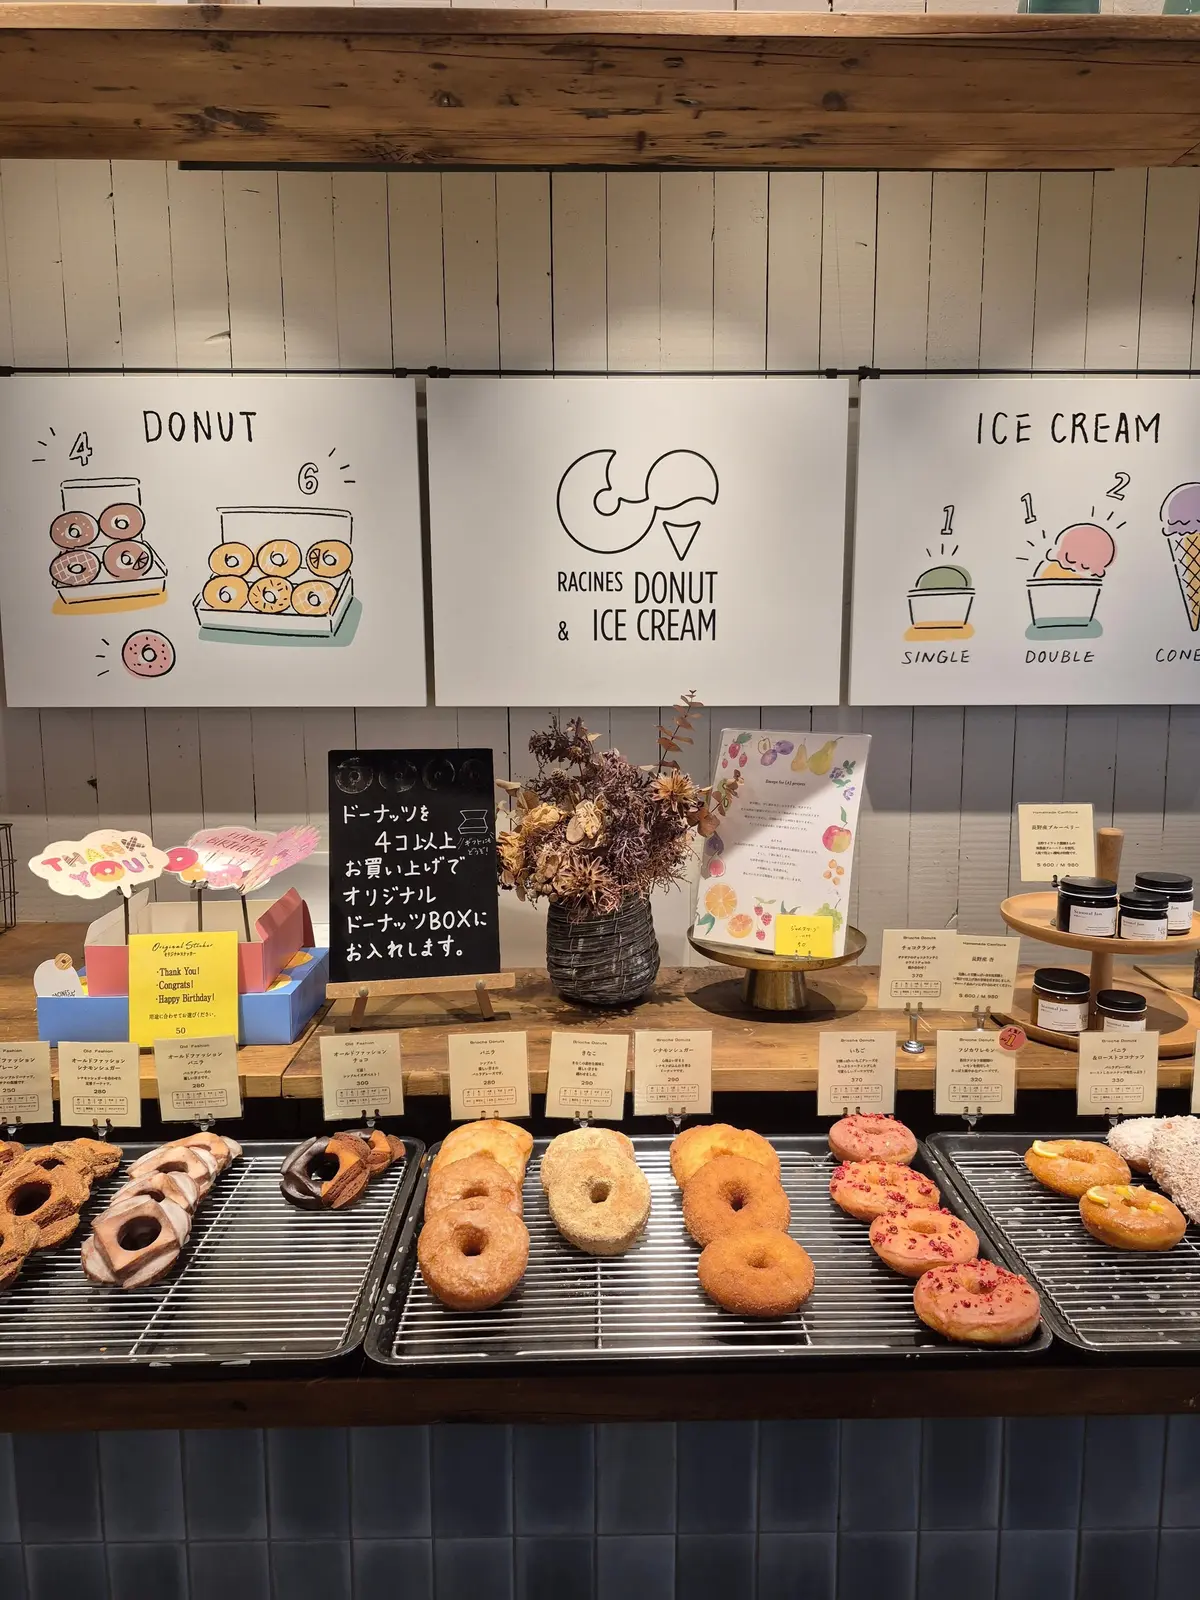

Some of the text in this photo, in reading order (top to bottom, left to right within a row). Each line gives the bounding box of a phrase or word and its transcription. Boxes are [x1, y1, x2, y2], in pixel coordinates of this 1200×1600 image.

[143, 410, 257, 443] DONUT
[977, 411, 1161, 445] ICE CREAM
[69, 431, 93, 466] 4
[297, 462, 319, 495] 6
[1107, 471, 1131, 501] 2
[940, 504, 956, 536] 1
[1020, 492, 1037, 524] 1
[557, 570, 718, 605] RACINES DONUT
[558, 608, 717, 642] & ICE CREAM
[901, 649, 971, 665] SINGLE
[1025, 649, 1095, 665] DOUBLE
[343, 803, 430, 824] ドーナッツを
[206, 836, 265, 857] BIRTHDAY
[227, 831, 269, 847] HAPPY
[41, 836, 146, 872] THANK
[344, 856, 466, 879] お買い上げで
[342, 885, 436, 907] オリジナル
[347, 908, 488, 934] ドーナッツBOXに
[346, 935, 463, 962] お入れします。
[184, 966, 200, 976] You!
[182, 992, 215, 1003] Birthday!
[175, 1027, 186, 1035] 50
[167, 1051, 223, 1060] オールドファッション
[333, 1049, 388, 1057] オールドファッション
